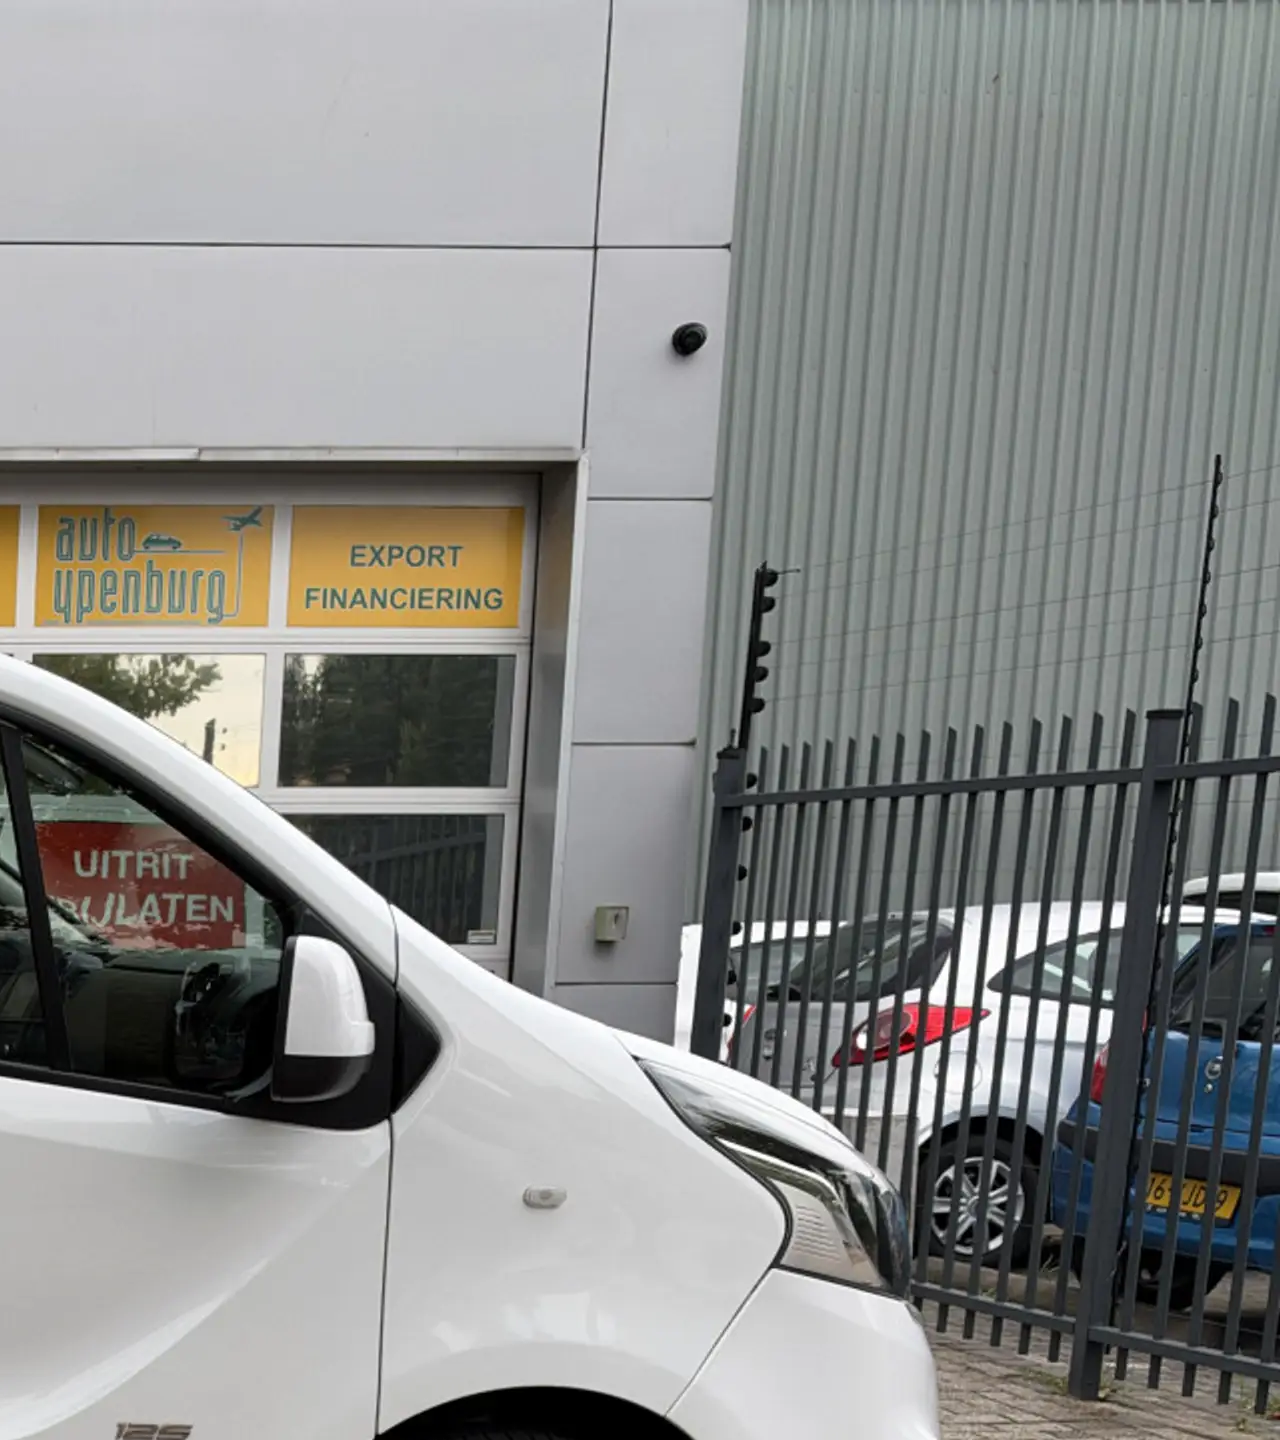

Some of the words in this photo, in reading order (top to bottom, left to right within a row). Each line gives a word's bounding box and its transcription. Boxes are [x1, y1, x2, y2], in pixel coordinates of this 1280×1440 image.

[54, 507, 136, 562] auto
[349, 544, 464, 568] EXPORT
[54, 560, 225, 623] ypenburg
[304, 587, 504, 610] FINANCIERING
[73, 849, 194, 880] UITRIT
